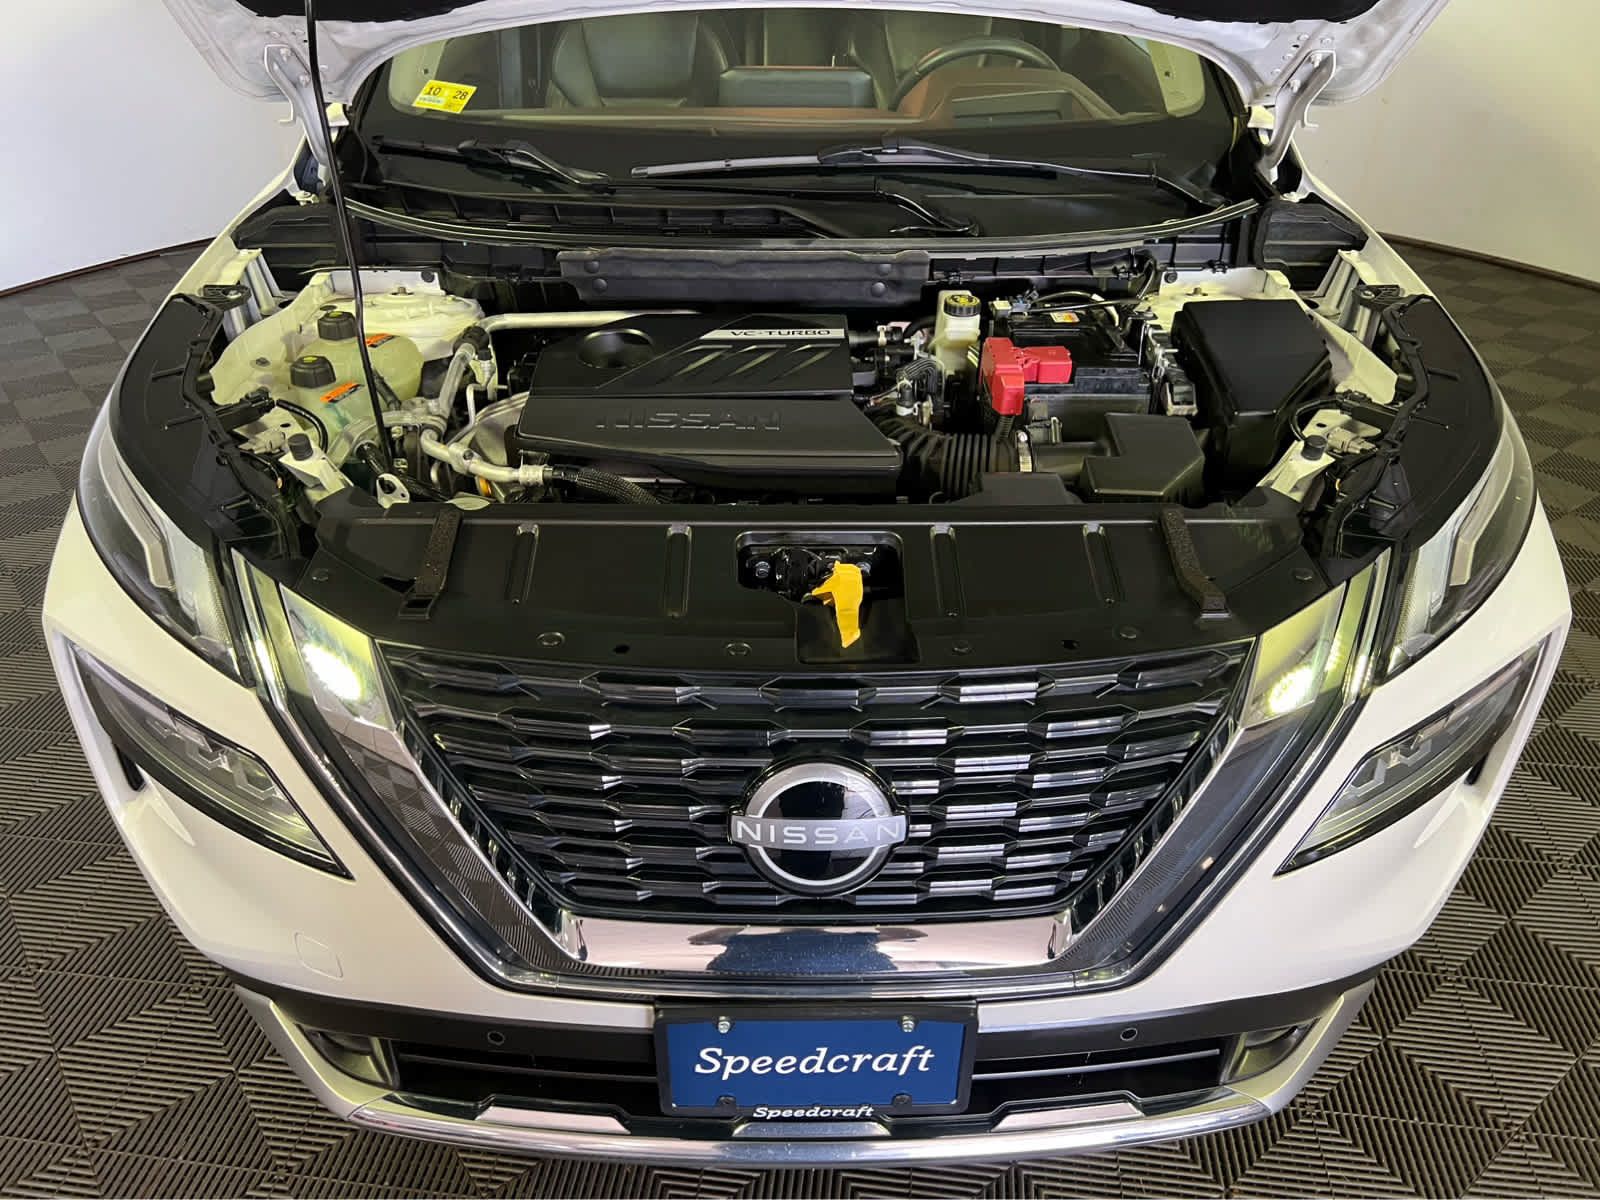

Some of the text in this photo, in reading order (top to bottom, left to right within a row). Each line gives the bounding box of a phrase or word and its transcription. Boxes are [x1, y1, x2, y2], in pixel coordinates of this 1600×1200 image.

[426, 86, 469, 100] 10 28
[594, 409, 783, 431] NISSAN
[736, 821, 900, 844] NISSAN
[694, 1045, 934, 1081] Speedcraft
[753, 1105, 875, 1119] Speedcraft
